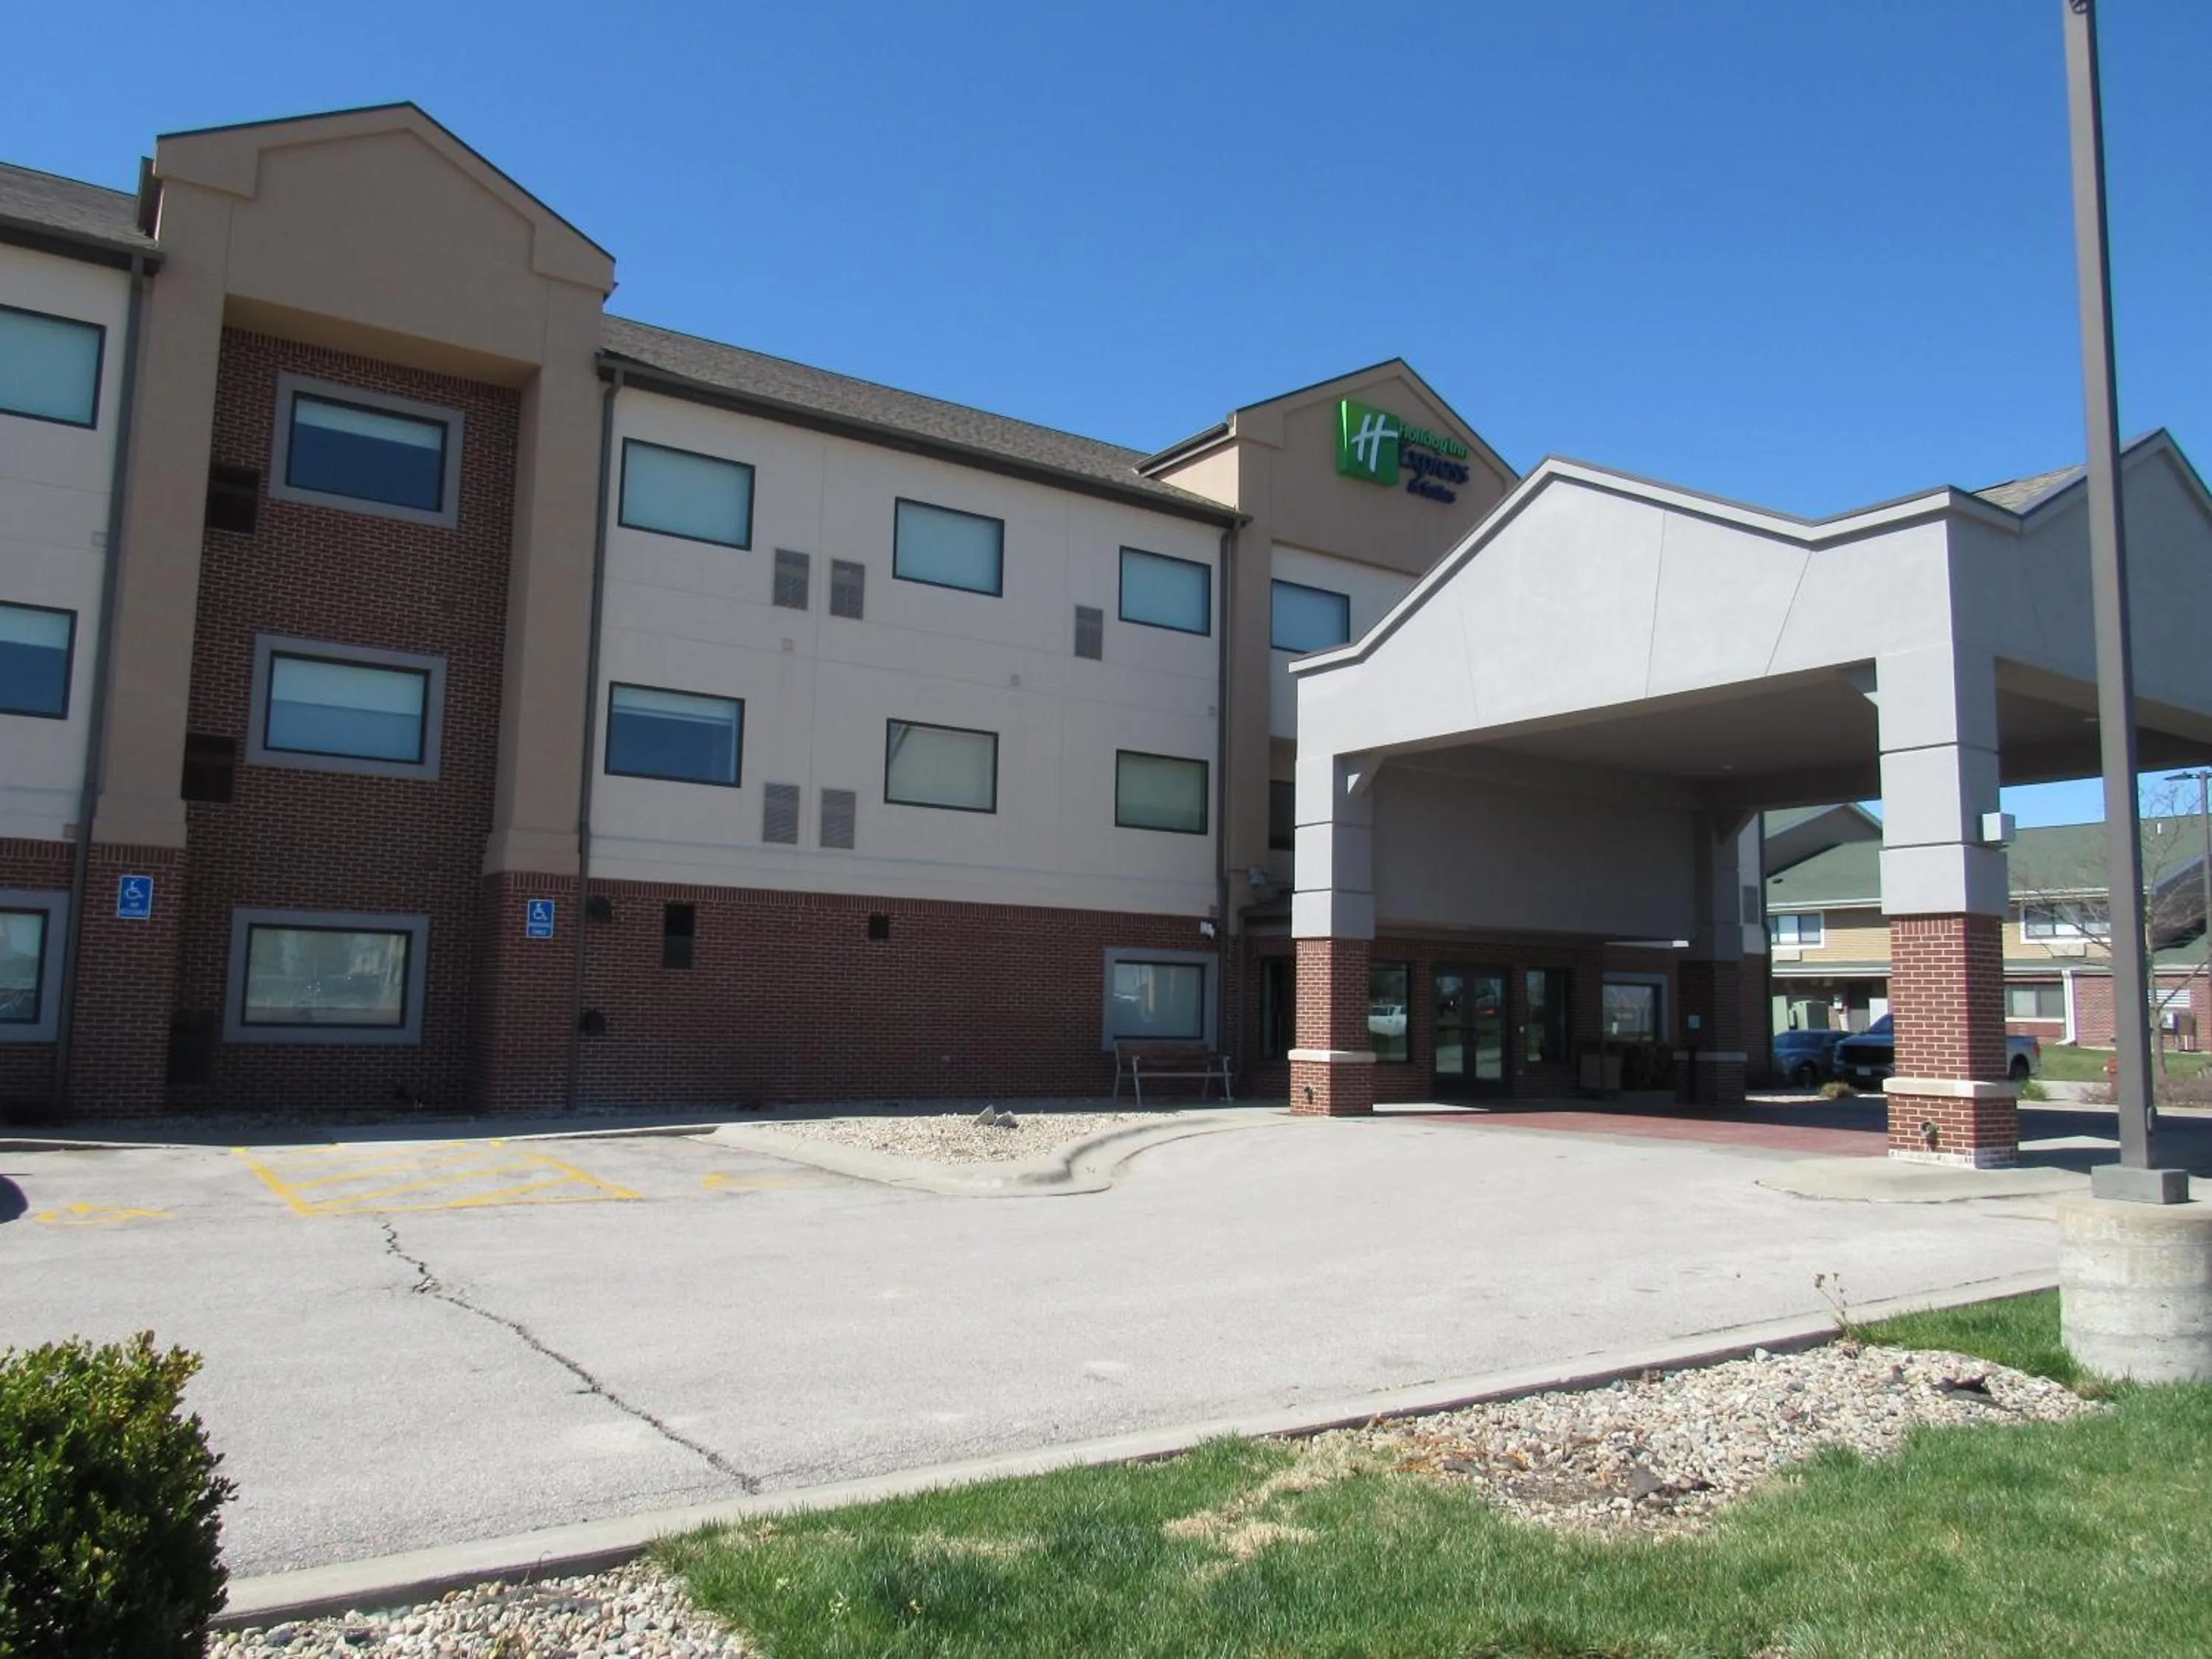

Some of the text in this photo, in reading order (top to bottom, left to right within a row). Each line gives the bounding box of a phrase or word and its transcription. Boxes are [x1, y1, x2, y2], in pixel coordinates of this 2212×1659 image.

[1351, 414, 1398, 472] H
[1399, 422, 1469, 459] Holiday Inn
